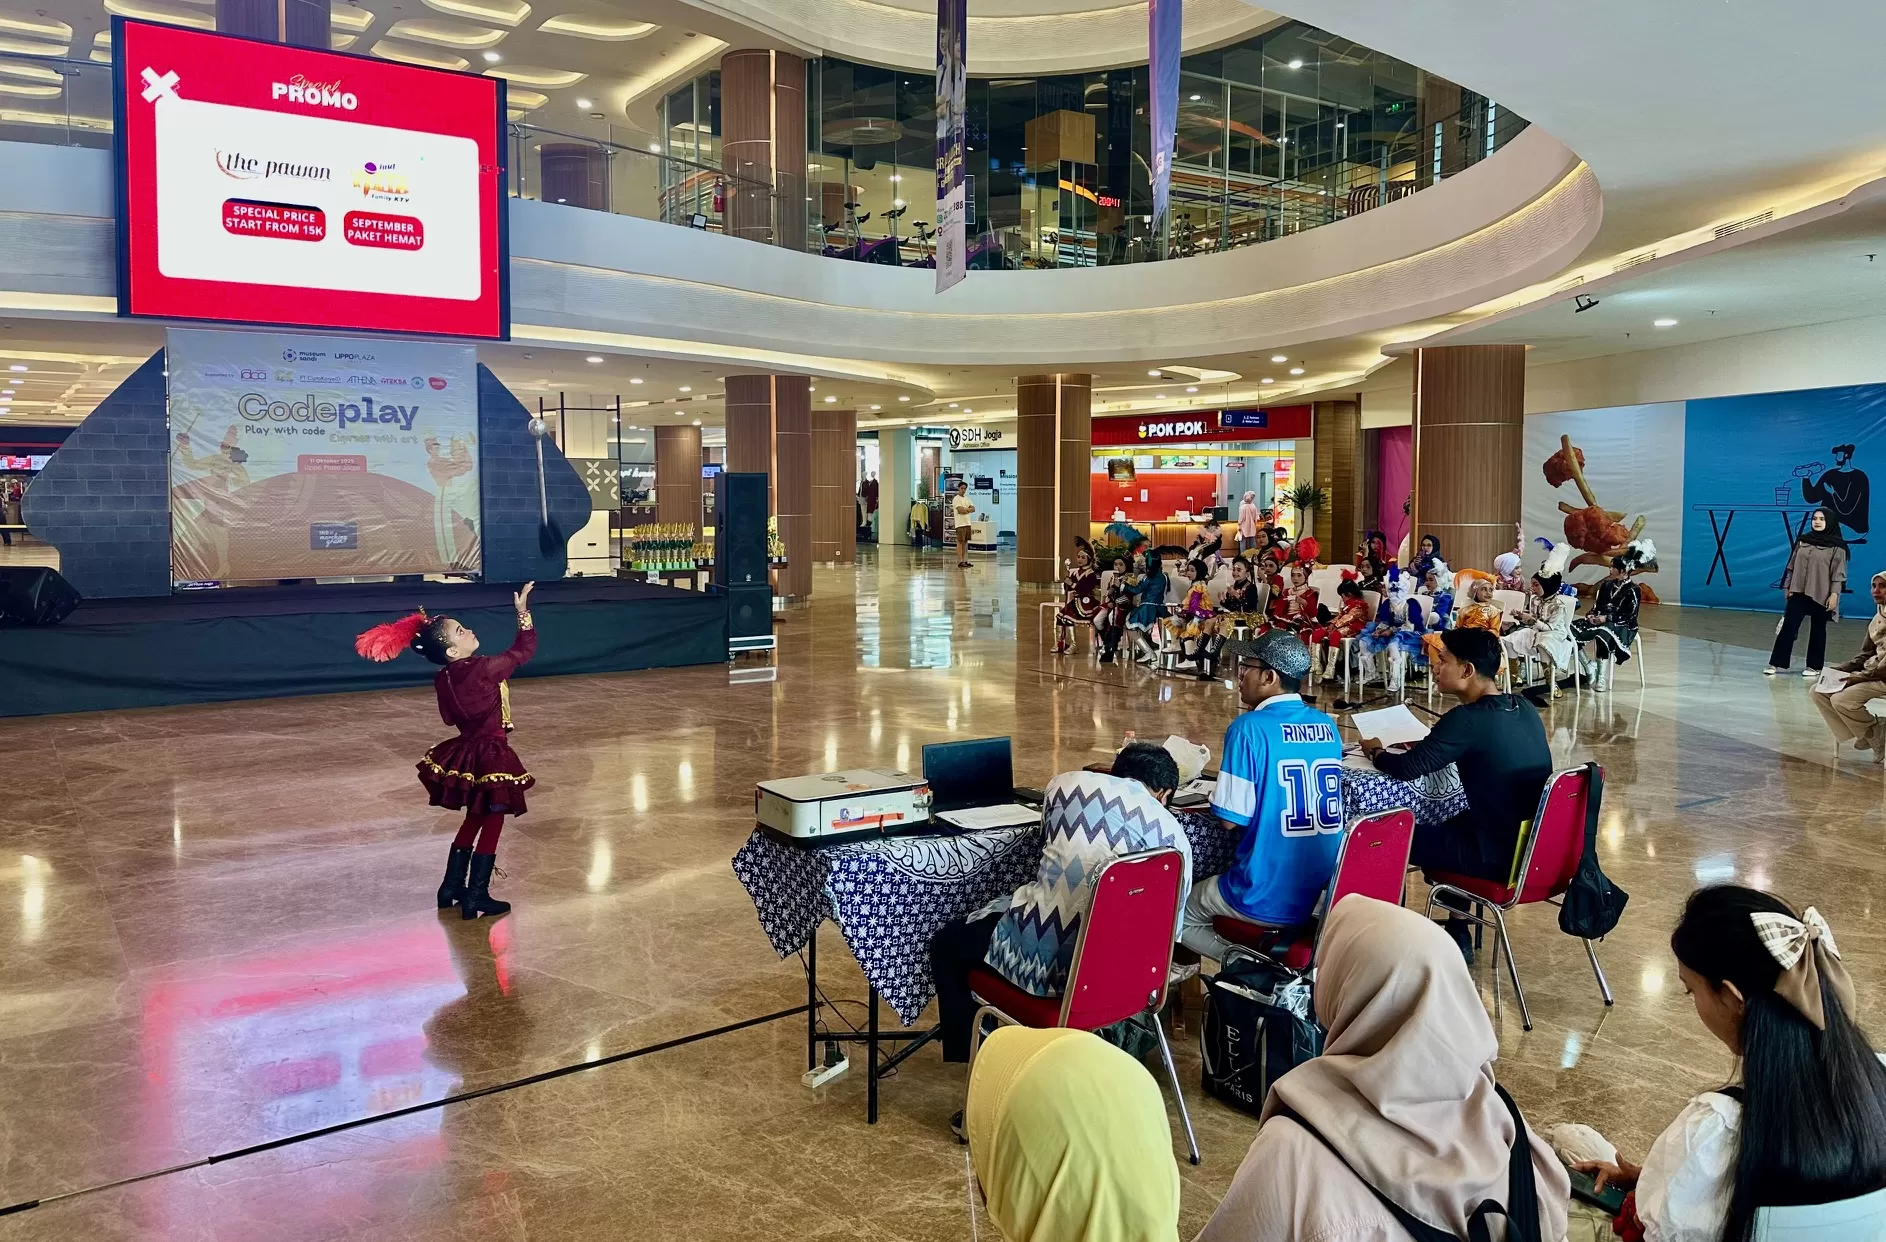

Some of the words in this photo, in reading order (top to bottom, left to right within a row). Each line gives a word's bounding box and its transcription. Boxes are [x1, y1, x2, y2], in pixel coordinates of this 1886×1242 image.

[290, 74, 341, 93] Special
[272, 82, 358, 110] PROMO
[227, 152, 258, 171] the
[265, 160, 332, 180] pawon
[233, 205, 280, 220] SPECIAL
[284, 209, 316, 223] PRICE
[225, 217, 263, 231] START
[265, 221, 299, 234] FROM
[303, 224, 323, 236] 15K
[352, 217, 414, 233] SEPTEMBER
[347, 229, 381, 242] PAKET
[384, 233, 422, 246] HEMAT
[347, 375, 377, 386] ATHENA
[237, 393, 420, 431] Codeplay
[245, 425, 270, 436] Play
[274, 425, 298, 435] with
[302, 426, 326, 435] code
[962, 428, 981, 441] SDH
[984, 430, 1002, 441] Jogja
[1148, 424, 1174, 437] POK
[1176, 421, 1202, 436] POK
[373, 434, 397, 443] with
[401, 435, 418, 443] art
[1280, 723, 1335, 743] RINJUN
[1277, 758, 1343, 838] 18
